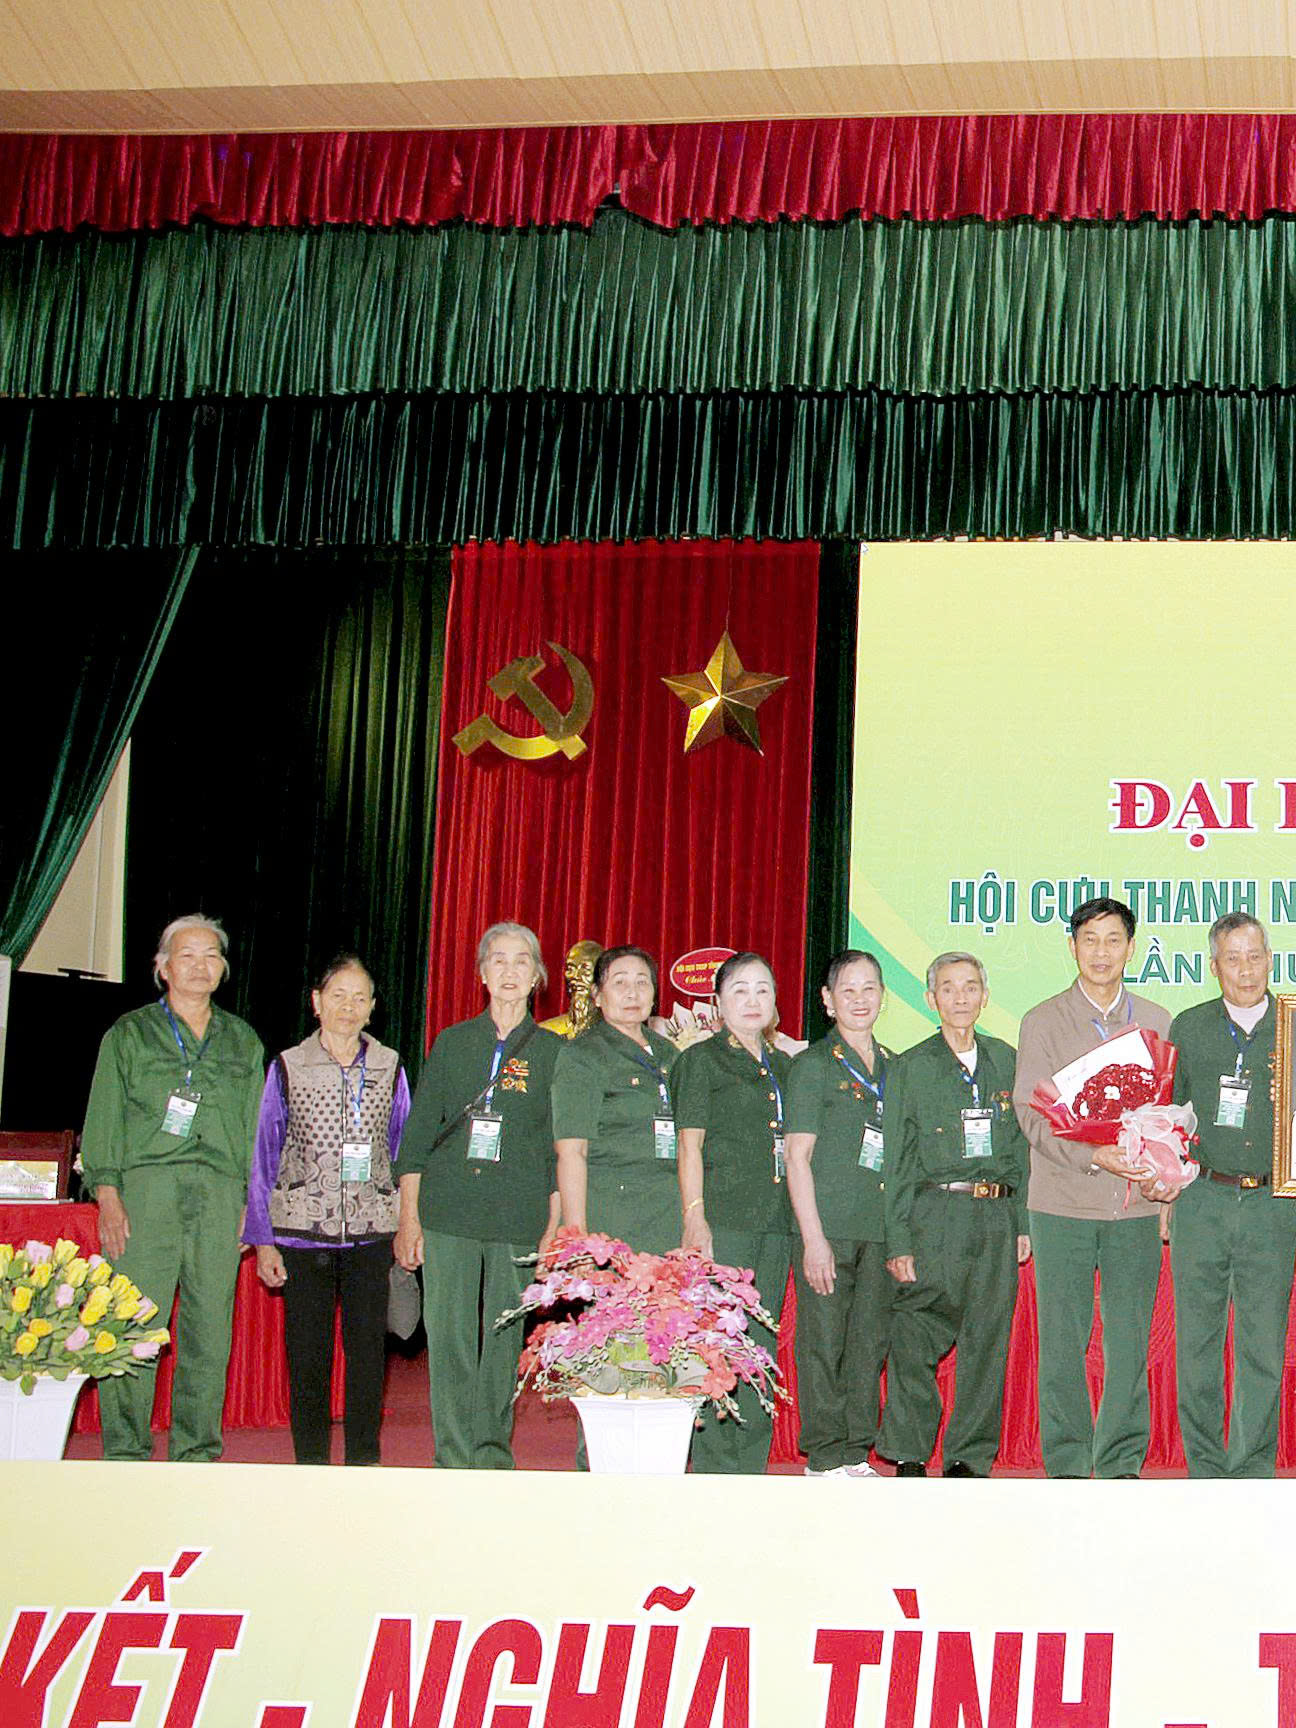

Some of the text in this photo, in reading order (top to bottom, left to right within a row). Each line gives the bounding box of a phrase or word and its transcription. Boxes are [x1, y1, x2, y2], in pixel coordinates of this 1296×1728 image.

[1112, 781, 1255, 847] ĐẠI
[951, 872, 1015, 932] HỘI
[1123, 881, 1256, 922] THANH
[0, 1551, 244, 1728] KẾT
[353, 1586, 750, 1728] NGHĨA
[812, 1588, 1115, 1728] TÌNH
